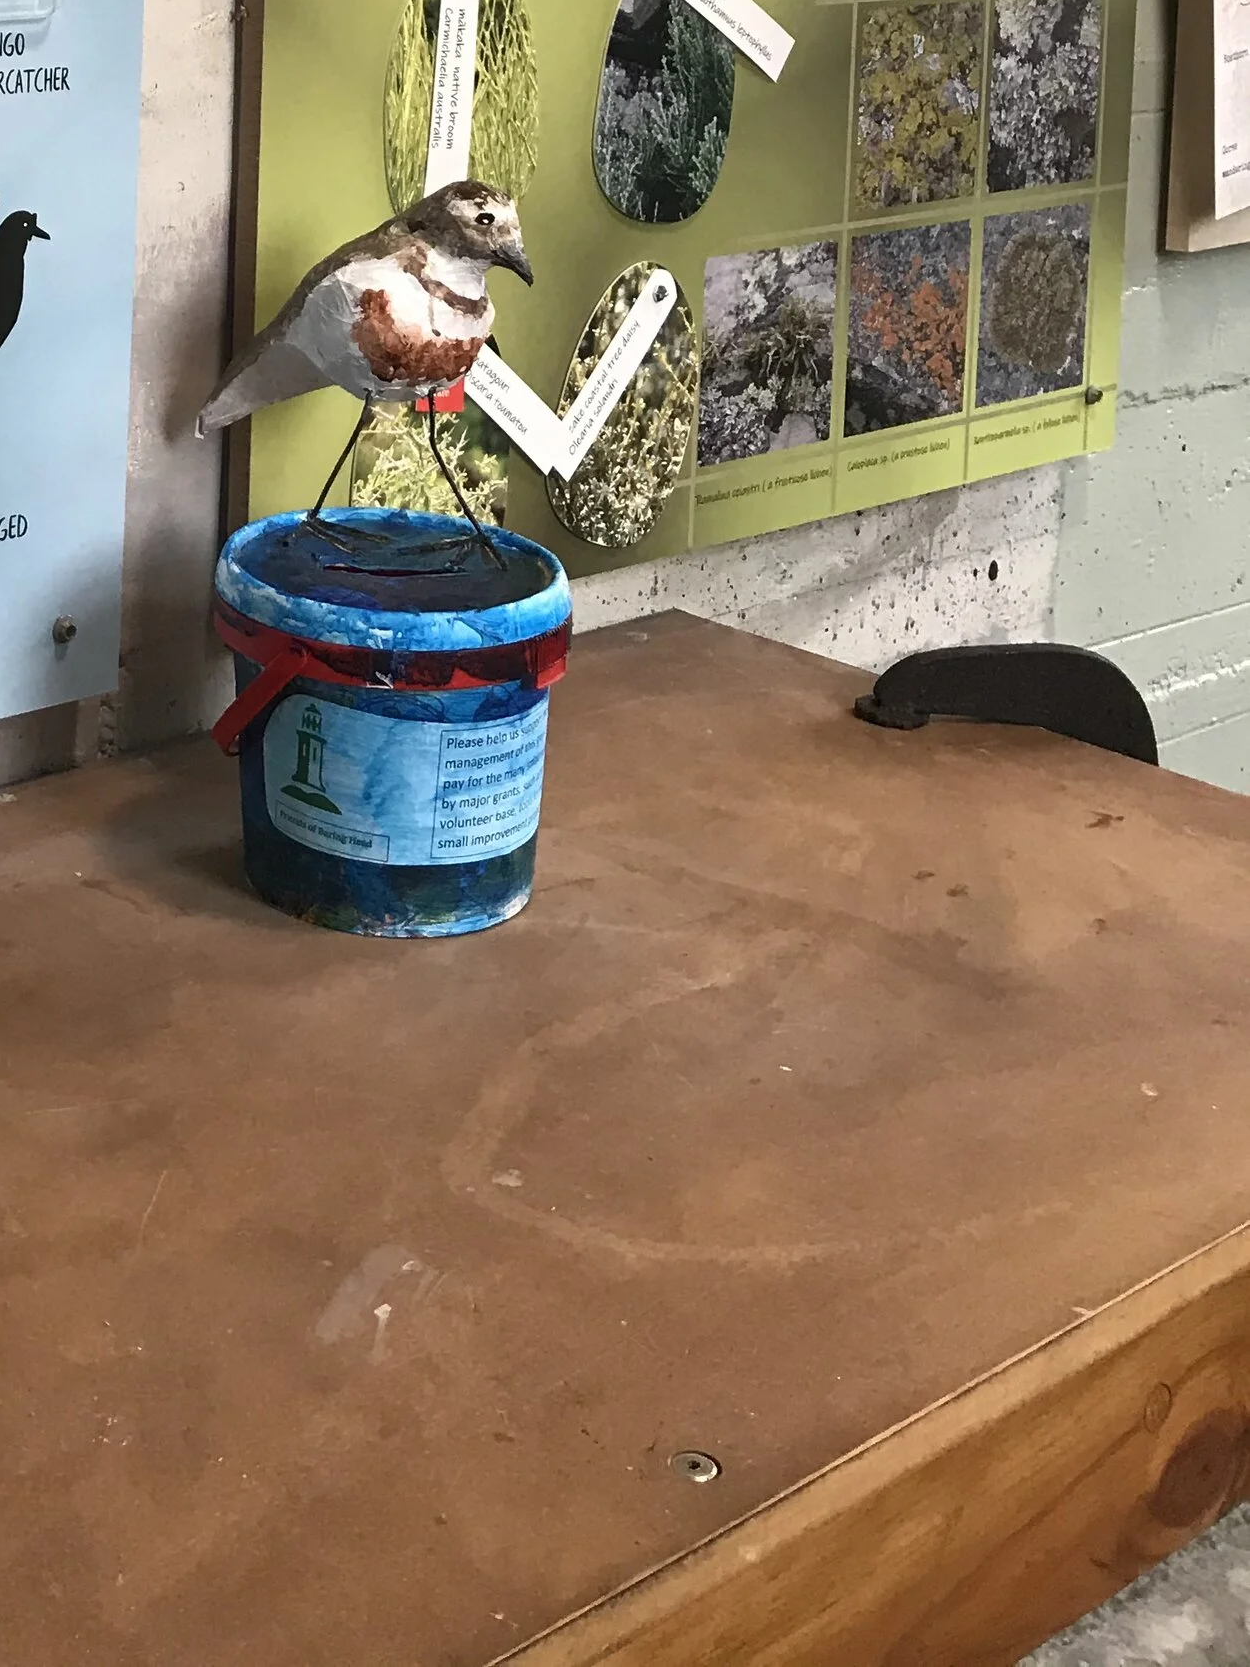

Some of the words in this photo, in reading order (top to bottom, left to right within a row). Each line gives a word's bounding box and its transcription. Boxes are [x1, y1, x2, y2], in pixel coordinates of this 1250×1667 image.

[437, 7, 454, 88] Carmichaelia
[450, 65, 465, 109] native
[431, 90, 446, 149] australis
[445, 110, 462, 150] broom
[584, 369, 608, 409] coastal
[607, 347, 624, 371] tree
[622, 319, 642, 347] daisy
[569, 418, 595, 455] Olearia
[446, 737, 484, 749] Please
[486, 732, 507, 745] help
[510, 730, 520, 740] us
[445, 749, 514, 769] management
[443, 779, 464, 791] pay
[467, 775, 483, 788] for
[486, 771, 502, 785] the
[441, 798, 456, 811] by
[459, 795, 491, 809] major
[440, 814, 493, 830] volunteer
[438, 834, 468, 849] small
